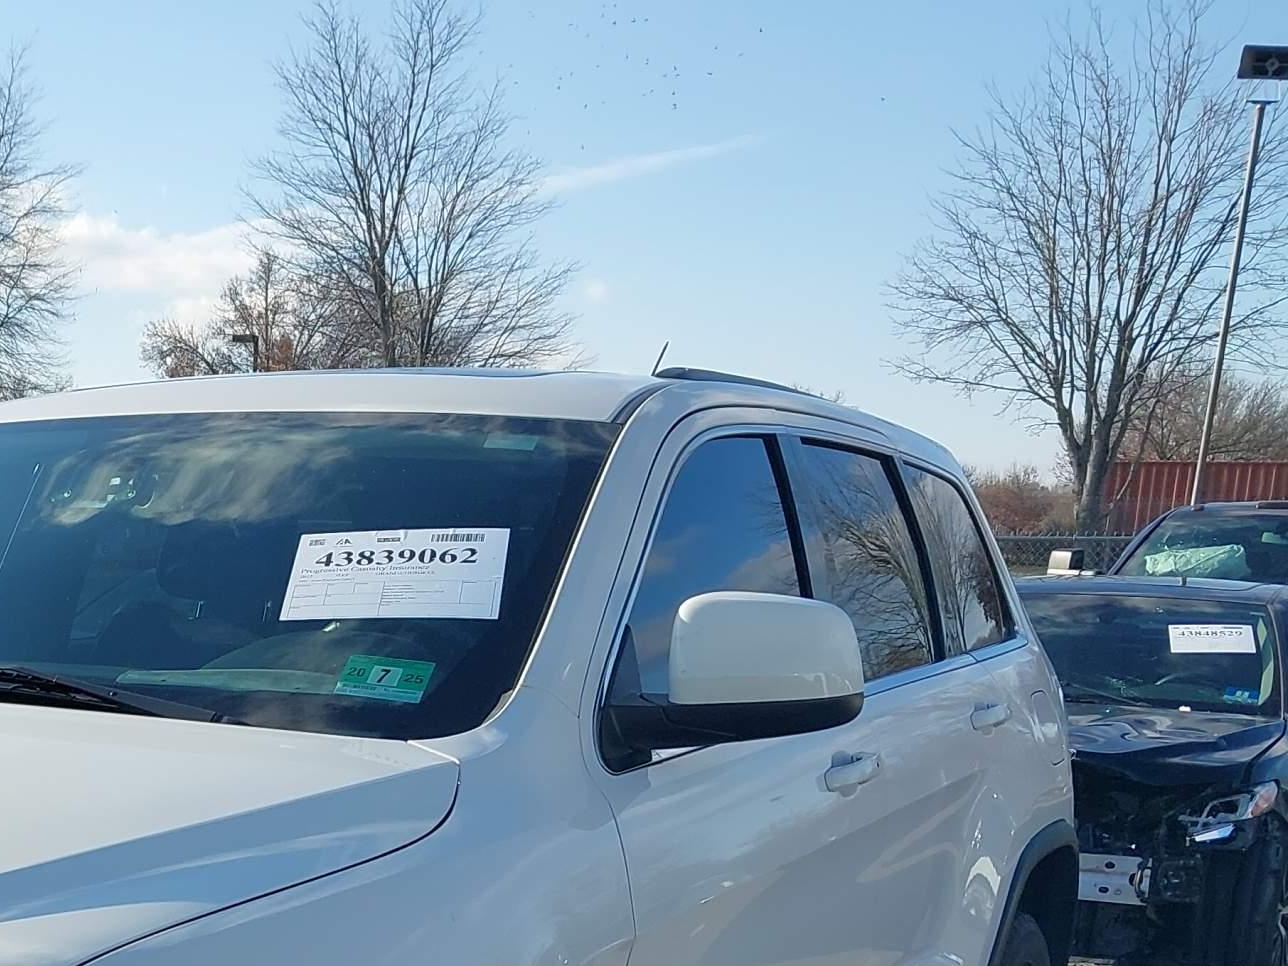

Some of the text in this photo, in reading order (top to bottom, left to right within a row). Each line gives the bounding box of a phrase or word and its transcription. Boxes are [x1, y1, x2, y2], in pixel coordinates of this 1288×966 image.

[315, 547, 479, 567] 43839062
[347, 667, 425, 684] 20 7 25
